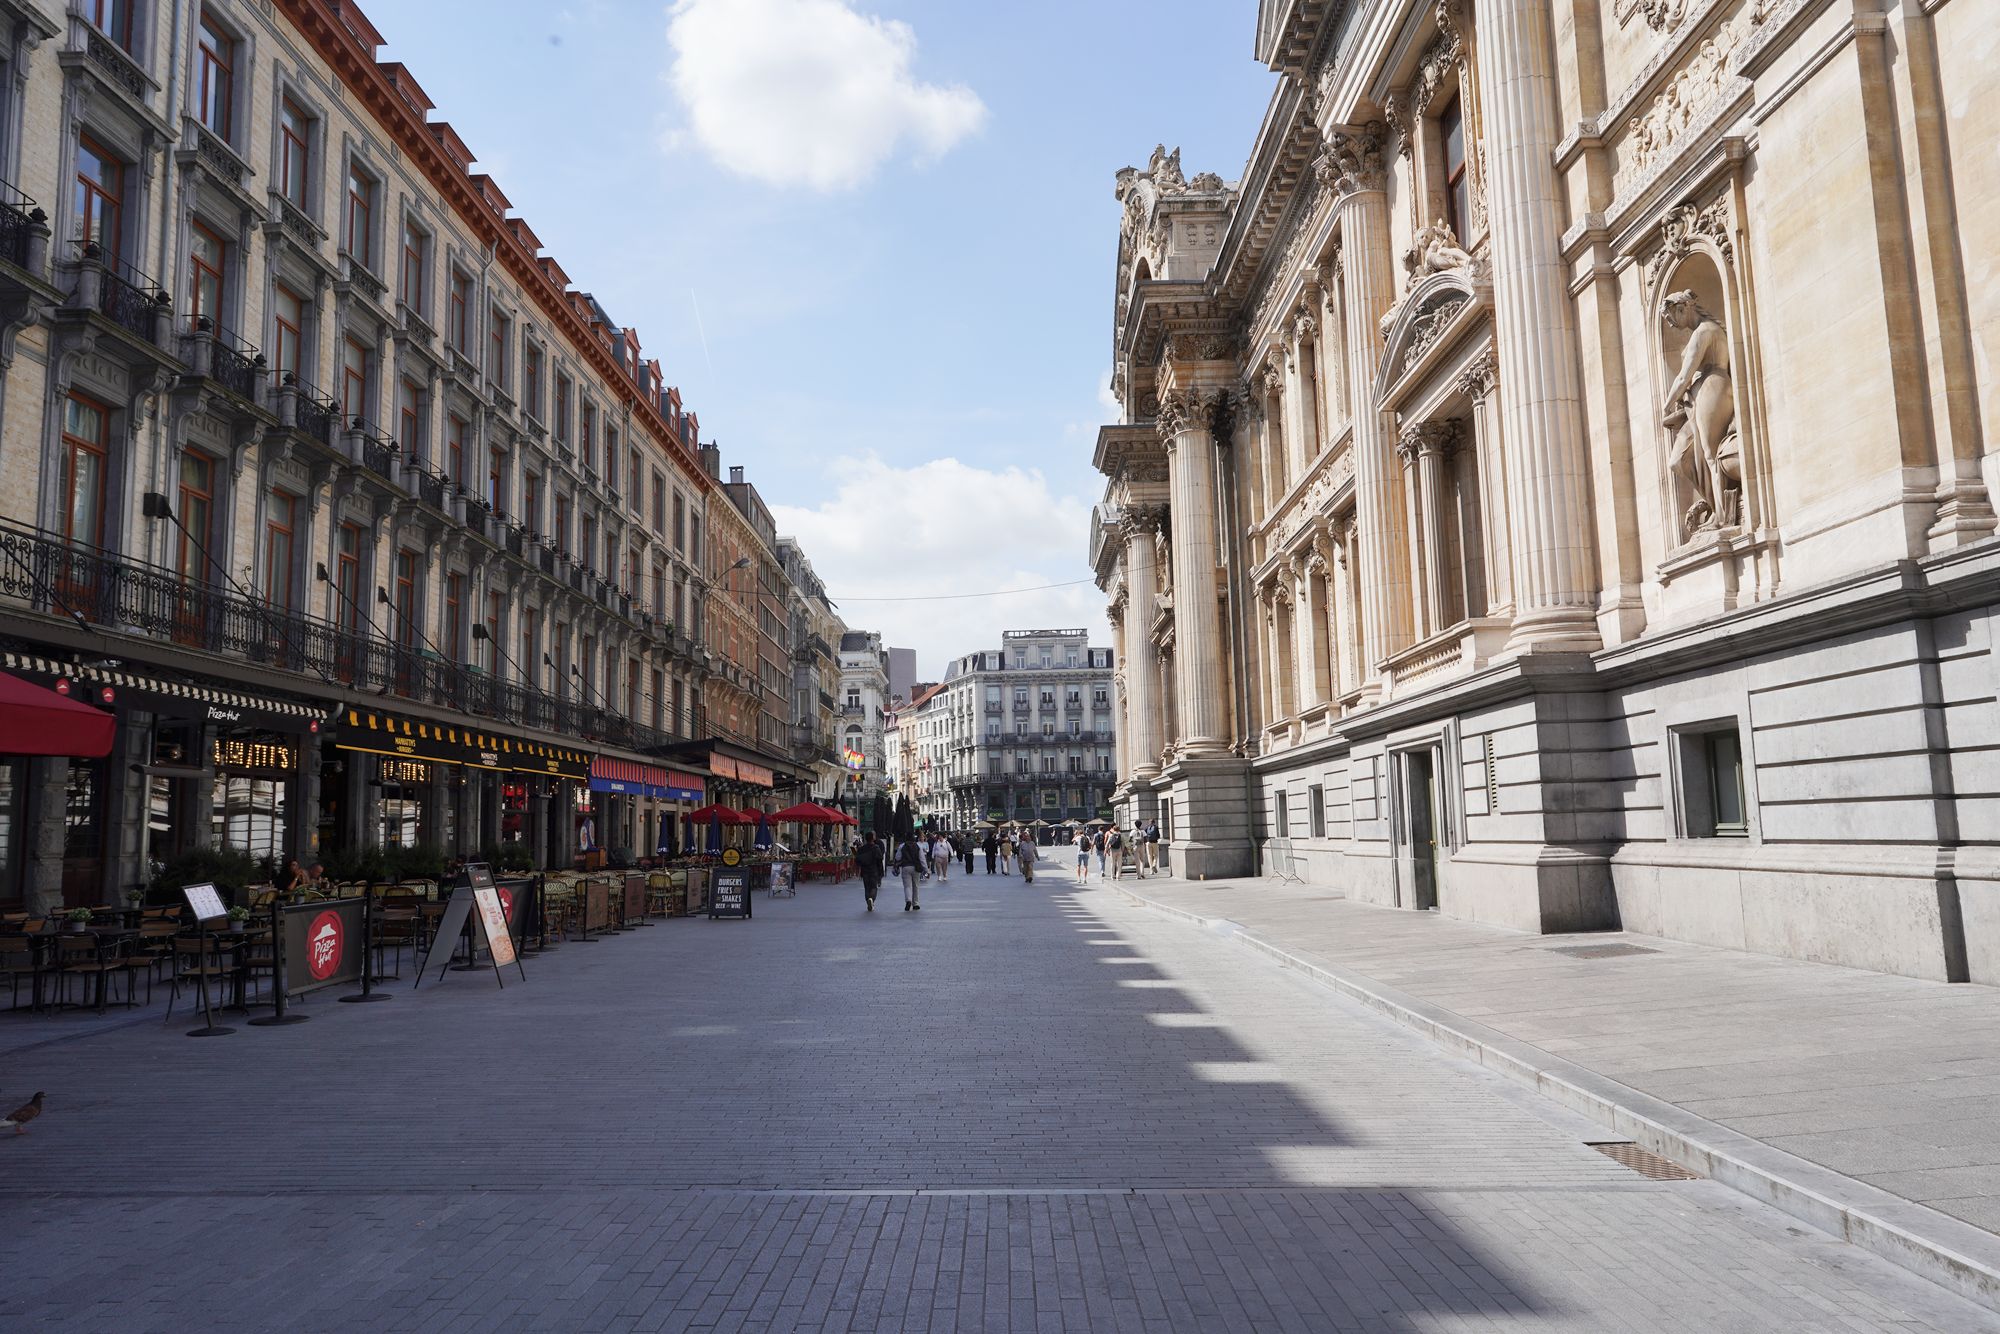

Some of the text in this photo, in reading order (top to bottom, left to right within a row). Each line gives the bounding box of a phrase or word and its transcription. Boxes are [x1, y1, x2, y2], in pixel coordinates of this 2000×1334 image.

[207, 706, 241, 721] Pizza Hut
[717, 886, 732, 894] FRIES
[315, 939, 336, 959] Pizza
[318, 949, 335, 968] Hut
